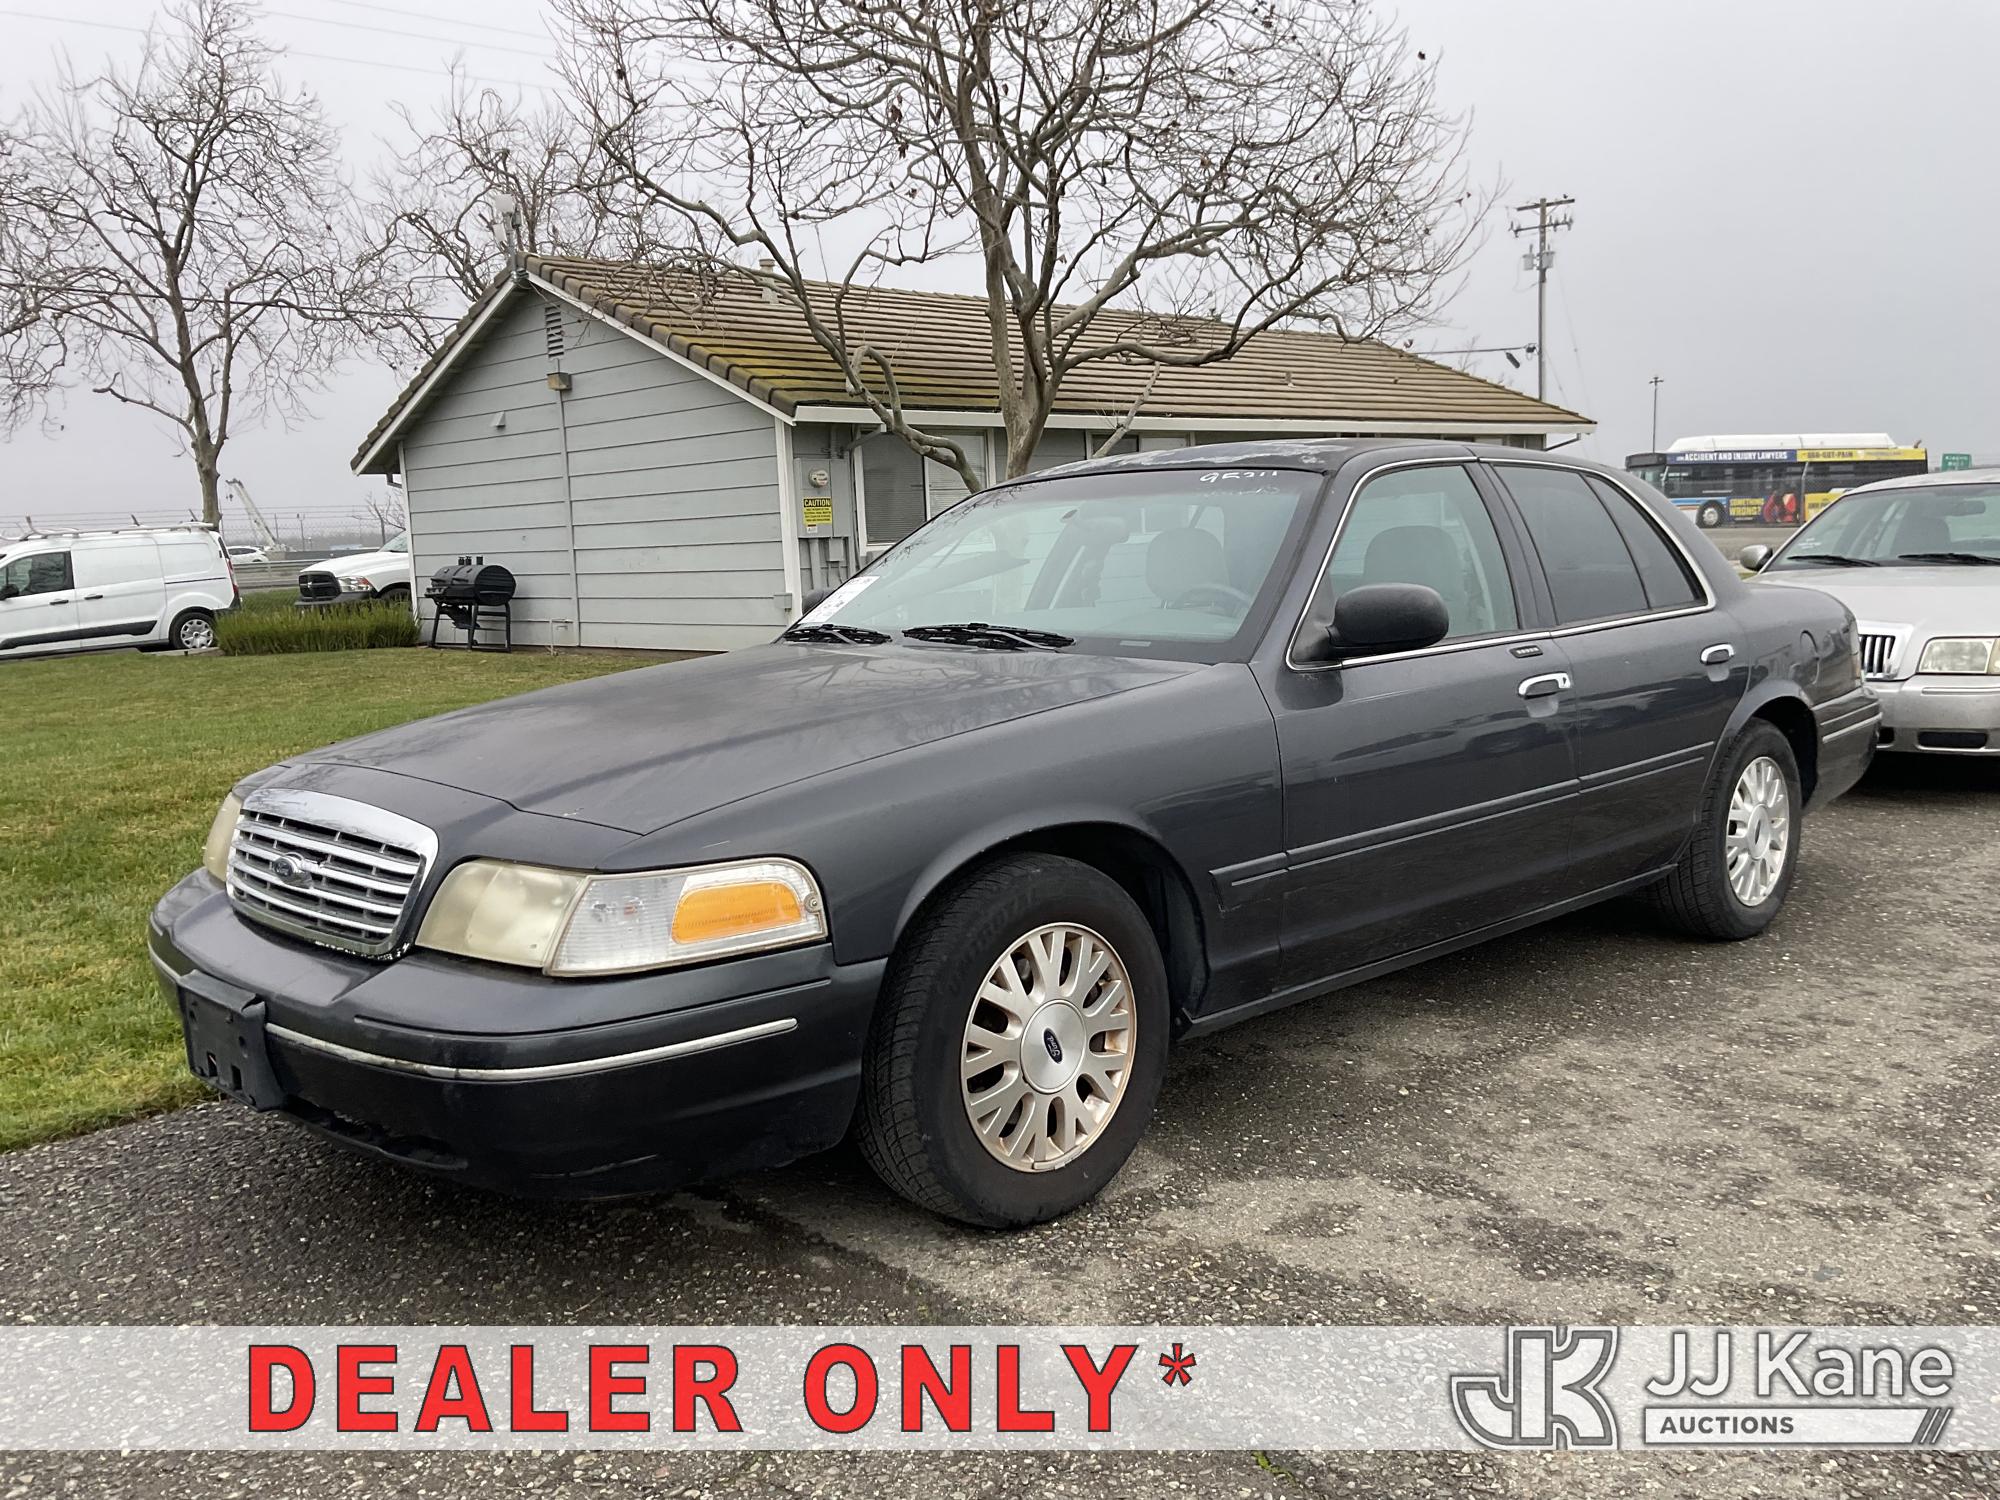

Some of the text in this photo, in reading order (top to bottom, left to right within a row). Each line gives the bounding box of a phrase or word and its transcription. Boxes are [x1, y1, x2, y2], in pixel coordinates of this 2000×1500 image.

[1684, 452, 1717, 461] ACCIDENT
[1718, 452, 1732, 461] AND
[1733, 452, 1756, 460] INJURY
[1757, 451, 1788, 460] LAWYERS
[804, 499, 831, 507] CAUTION
